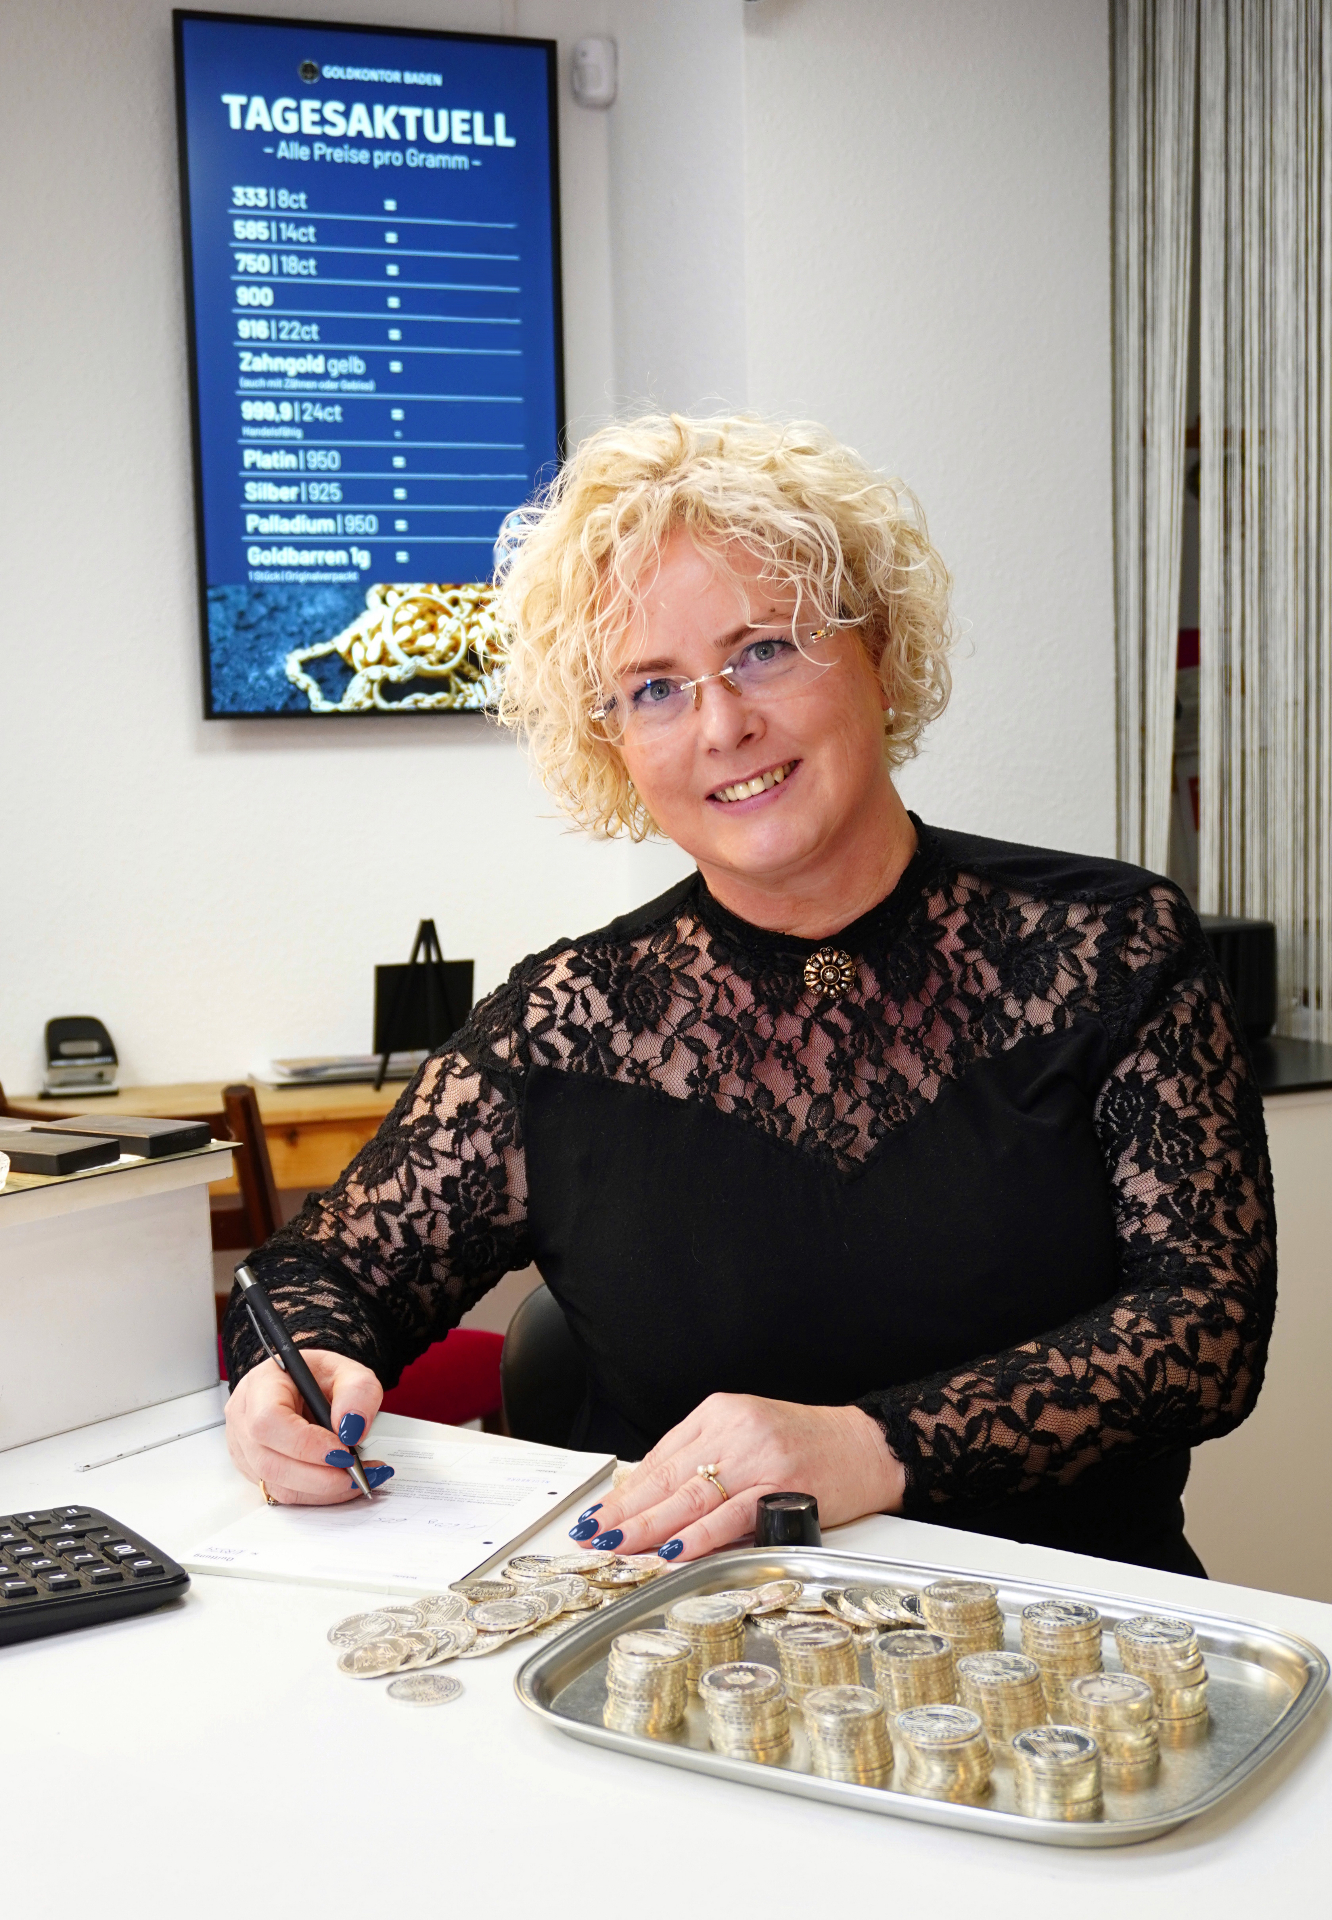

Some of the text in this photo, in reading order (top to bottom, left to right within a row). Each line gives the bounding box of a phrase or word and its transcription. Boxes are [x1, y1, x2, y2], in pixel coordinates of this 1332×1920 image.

[322, 65, 443, 86] GOLDKONTOR BADEN
[221, 94, 516, 147] TAGESAKTUELL
[277, 140, 310, 161] Alle
[314, 145, 370, 164] Preise
[373, 152, 402, 169] pro
[406, 150, 469, 171] Gramm
[232, 186, 267, 208] 333
[277, 189, 308, 209] 8ct
[233, 220, 269, 241] 585
[280, 222, 316, 244] 14ct
[235, 253, 270, 274] 750
[281, 255, 317, 276] 18ct
[236, 286, 274, 307] 900
[237, 318, 269, 340] 916
[279, 321, 320, 342] 22ct
[239, 352, 325, 378] Zahngold
[327, 356, 365, 380] gelb
[239, 377, 265, 389] (auch
[267, 378, 282, 389] mit
[318, 380, 339, 391] oder
[241, 401, 293, 422] 999,9
[302, 402, 343, 422] 24ct
[242, 426, 303, 439] Handelsfähig
[243, 449, 298, 470] Platin
[306, 450, 341, 470] 950
[244, 481, 299, 502] Silber
[308, 482, 342, 502] 925
[246, 513, 335, 534] Palladium
[344, 514, 378, 534] 950
[247, 545, 348, 566] Goldbarren
[350, 546, 371, 570] 1g
[254, 570, 280, 580] Stück
[285, 571, 359, 583] Originalverpackt
